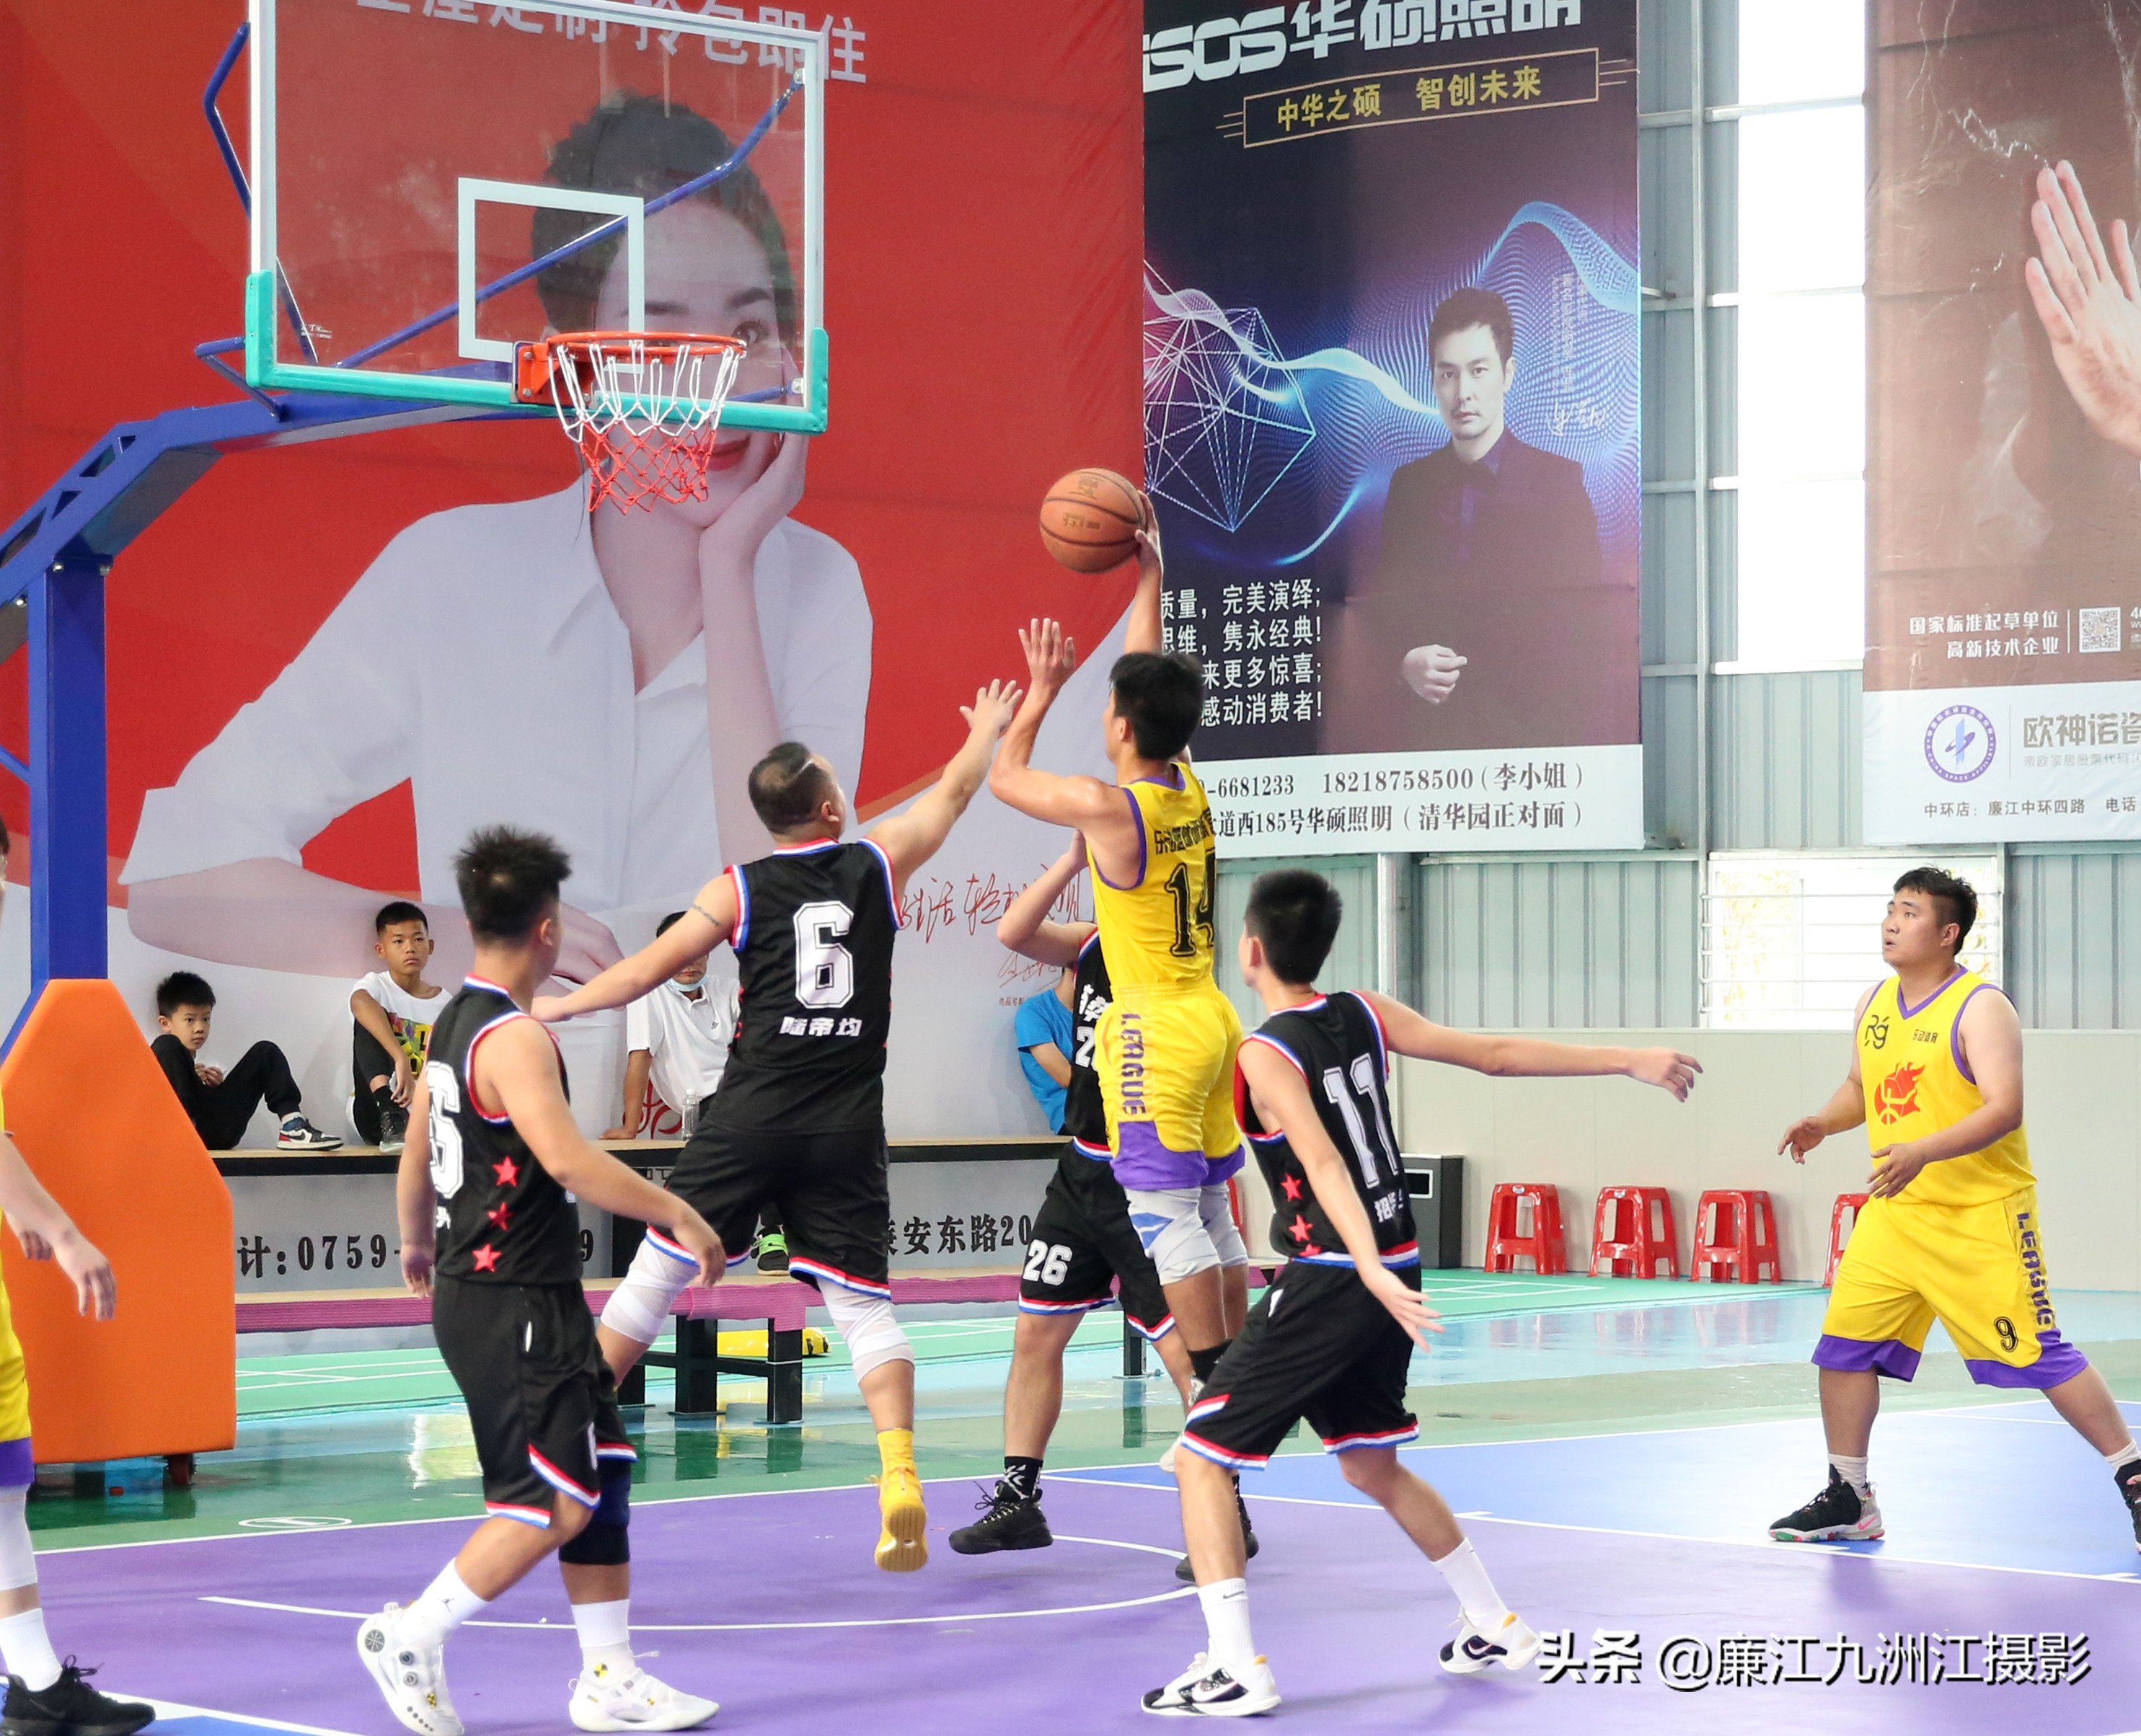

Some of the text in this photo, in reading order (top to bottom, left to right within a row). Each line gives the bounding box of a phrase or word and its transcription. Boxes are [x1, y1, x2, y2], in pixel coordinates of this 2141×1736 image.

[1277, 64, 1542, 132] 中华之硕 智创未来
[1910, 611, 2059, 635] 国家标准起草单位
[1946, 636, 2060, 659] 高新技术企业
[793, 900, 855, 1009] 6
[1075, 1026, 1098, 1071] 2
[1323, 1053, 1399, 1189] 11
[1022, 1239, 1073, 1286] 26
[1993, 1316, 2019, 1353] 9
